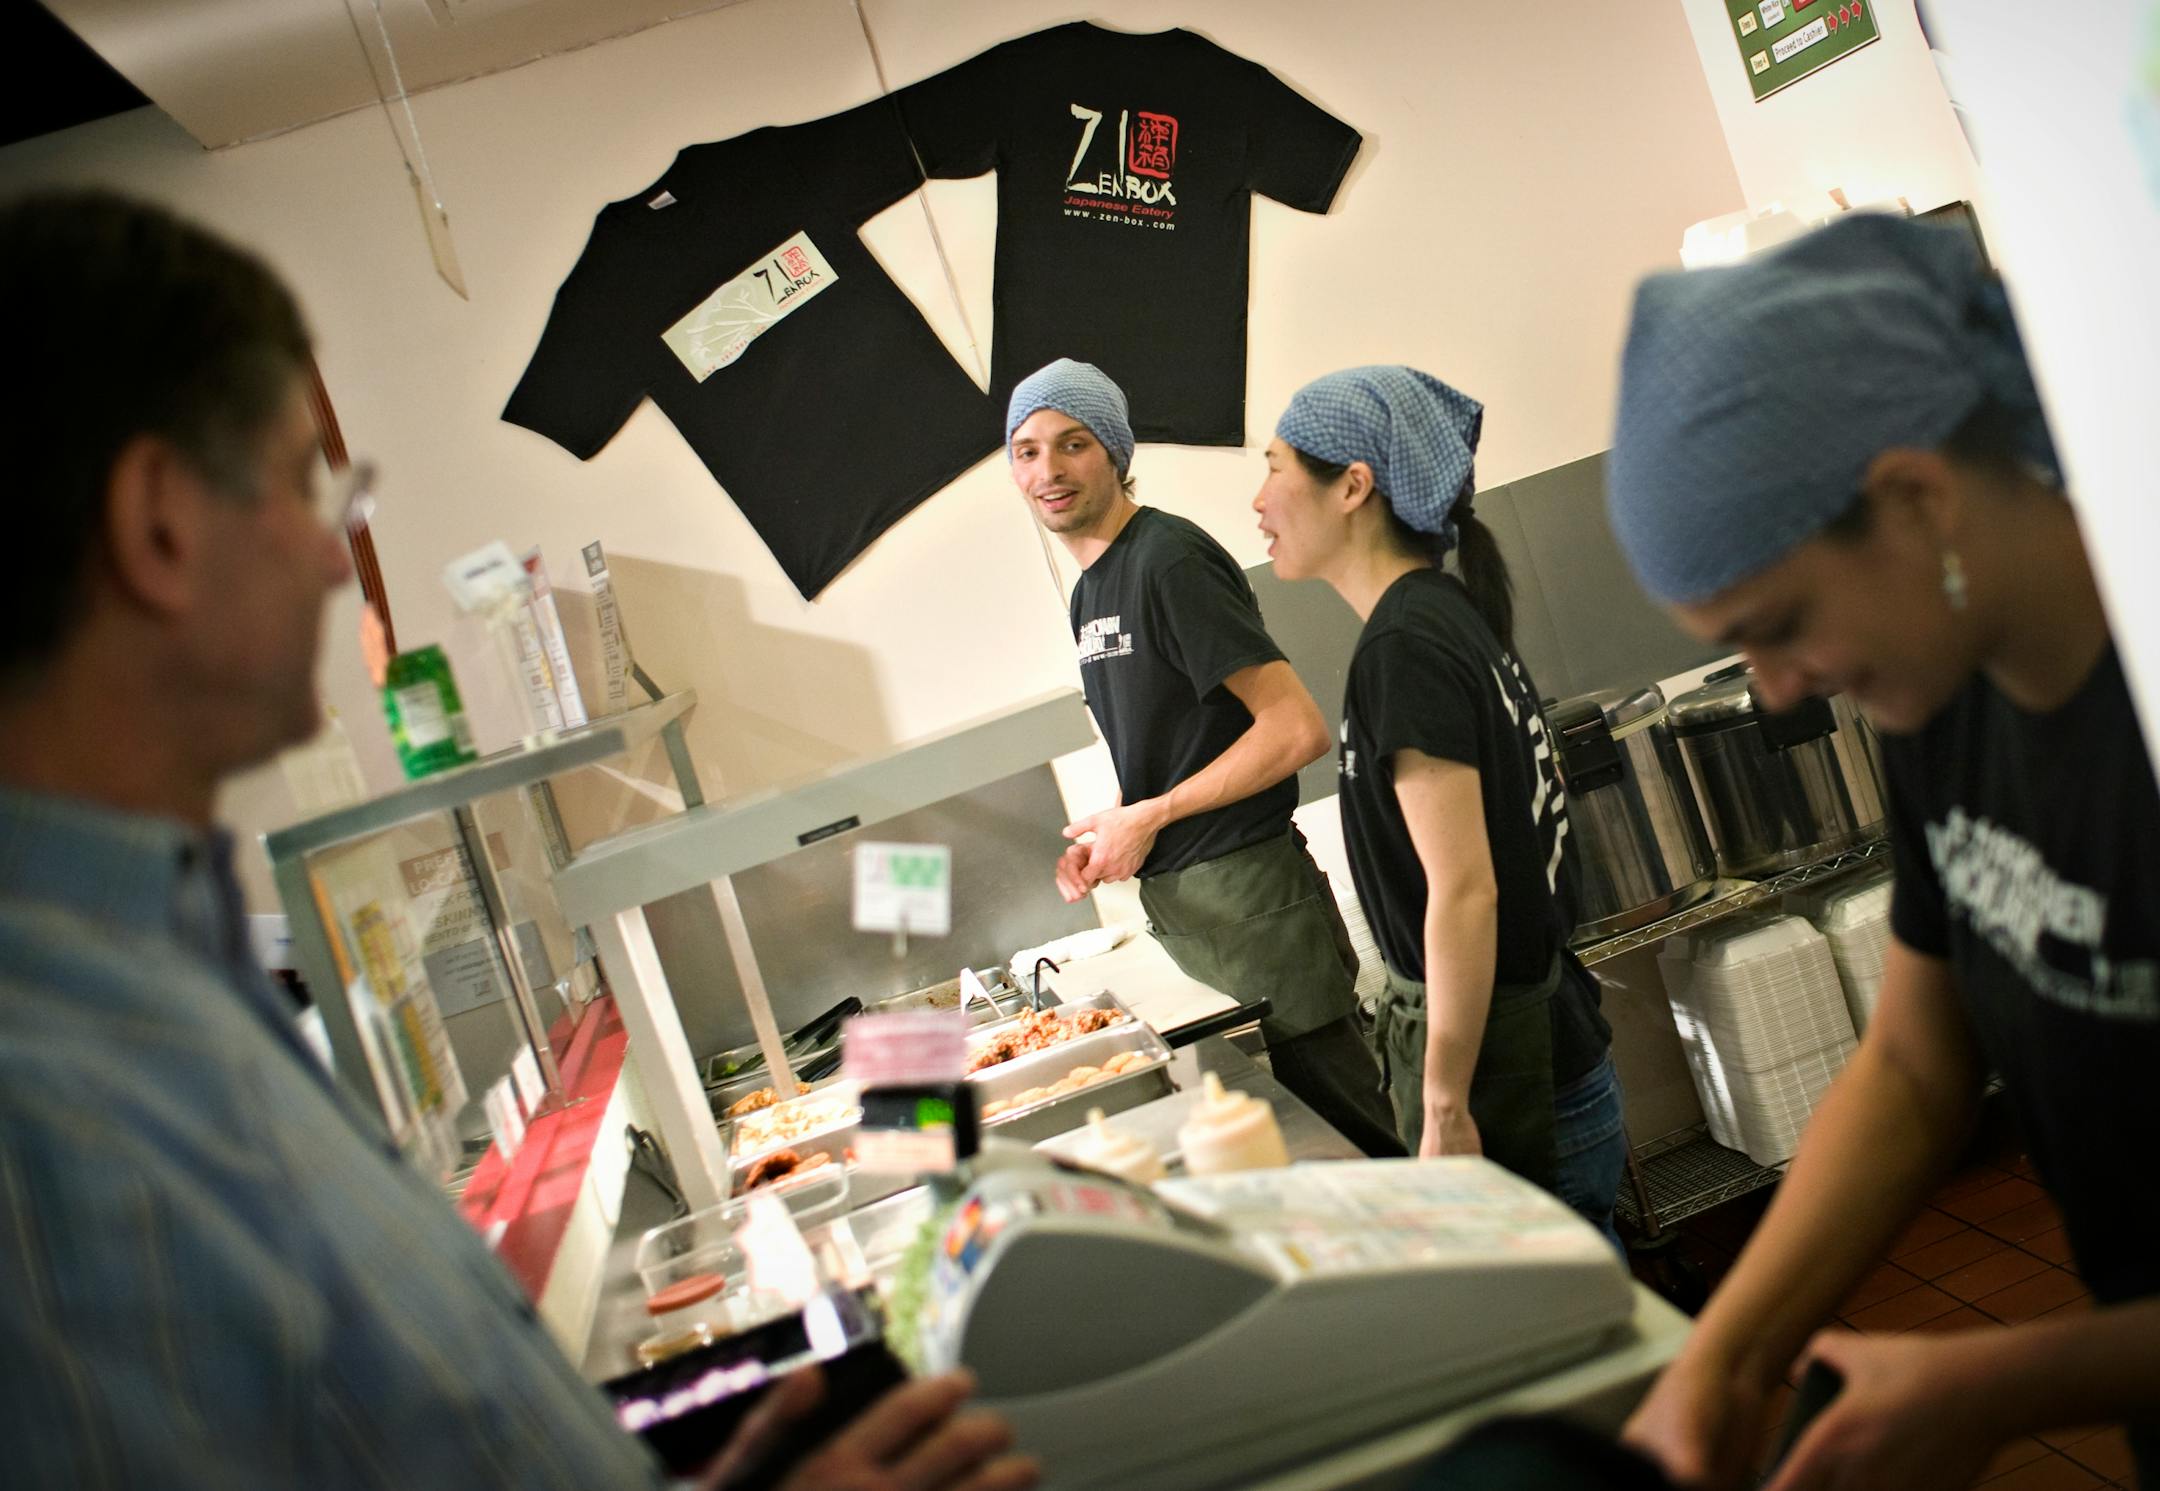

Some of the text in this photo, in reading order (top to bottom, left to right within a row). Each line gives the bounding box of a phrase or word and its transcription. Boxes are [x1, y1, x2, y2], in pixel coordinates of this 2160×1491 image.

[1774, 39, 1797, 57] Proceed
[1803, 25, 1824, 43] Cashier
[1064, 196, 1175, 219] Japanese Eatery
